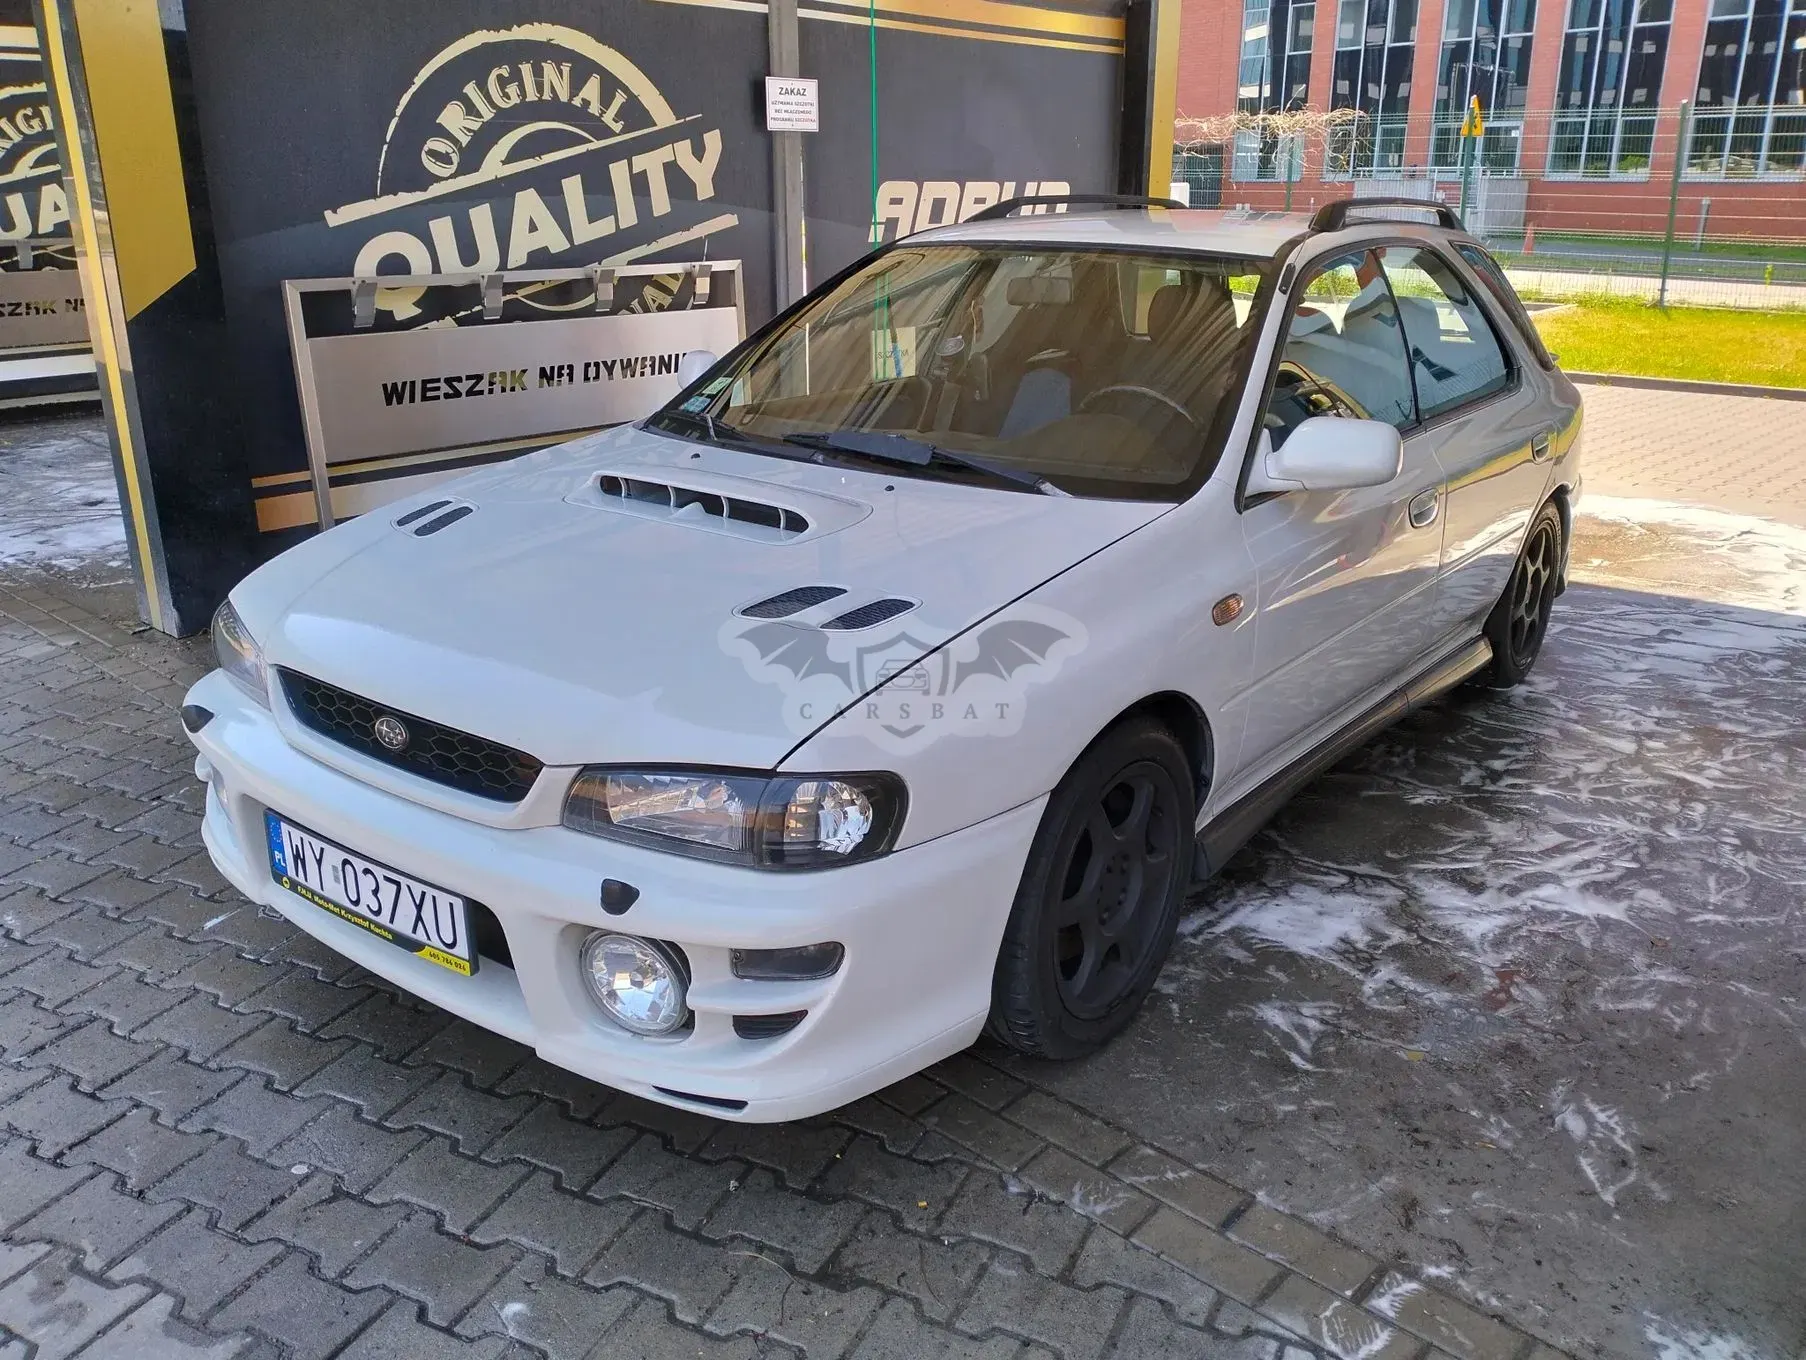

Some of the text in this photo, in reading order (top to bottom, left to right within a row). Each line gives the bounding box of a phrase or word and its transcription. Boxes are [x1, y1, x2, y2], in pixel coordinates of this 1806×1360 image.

[421, 59, 628, 178] ORIGINAL
[778, 87, 807, 97] ZAKAZ
[353, 129, 723, 321] QUALITY
[381, 368, 528, 407] WIESZAK
[538, 363, 574, 389] NA
[274, 850, 287, 867] PL
[287, 829, 458, 950] WY 037XU
